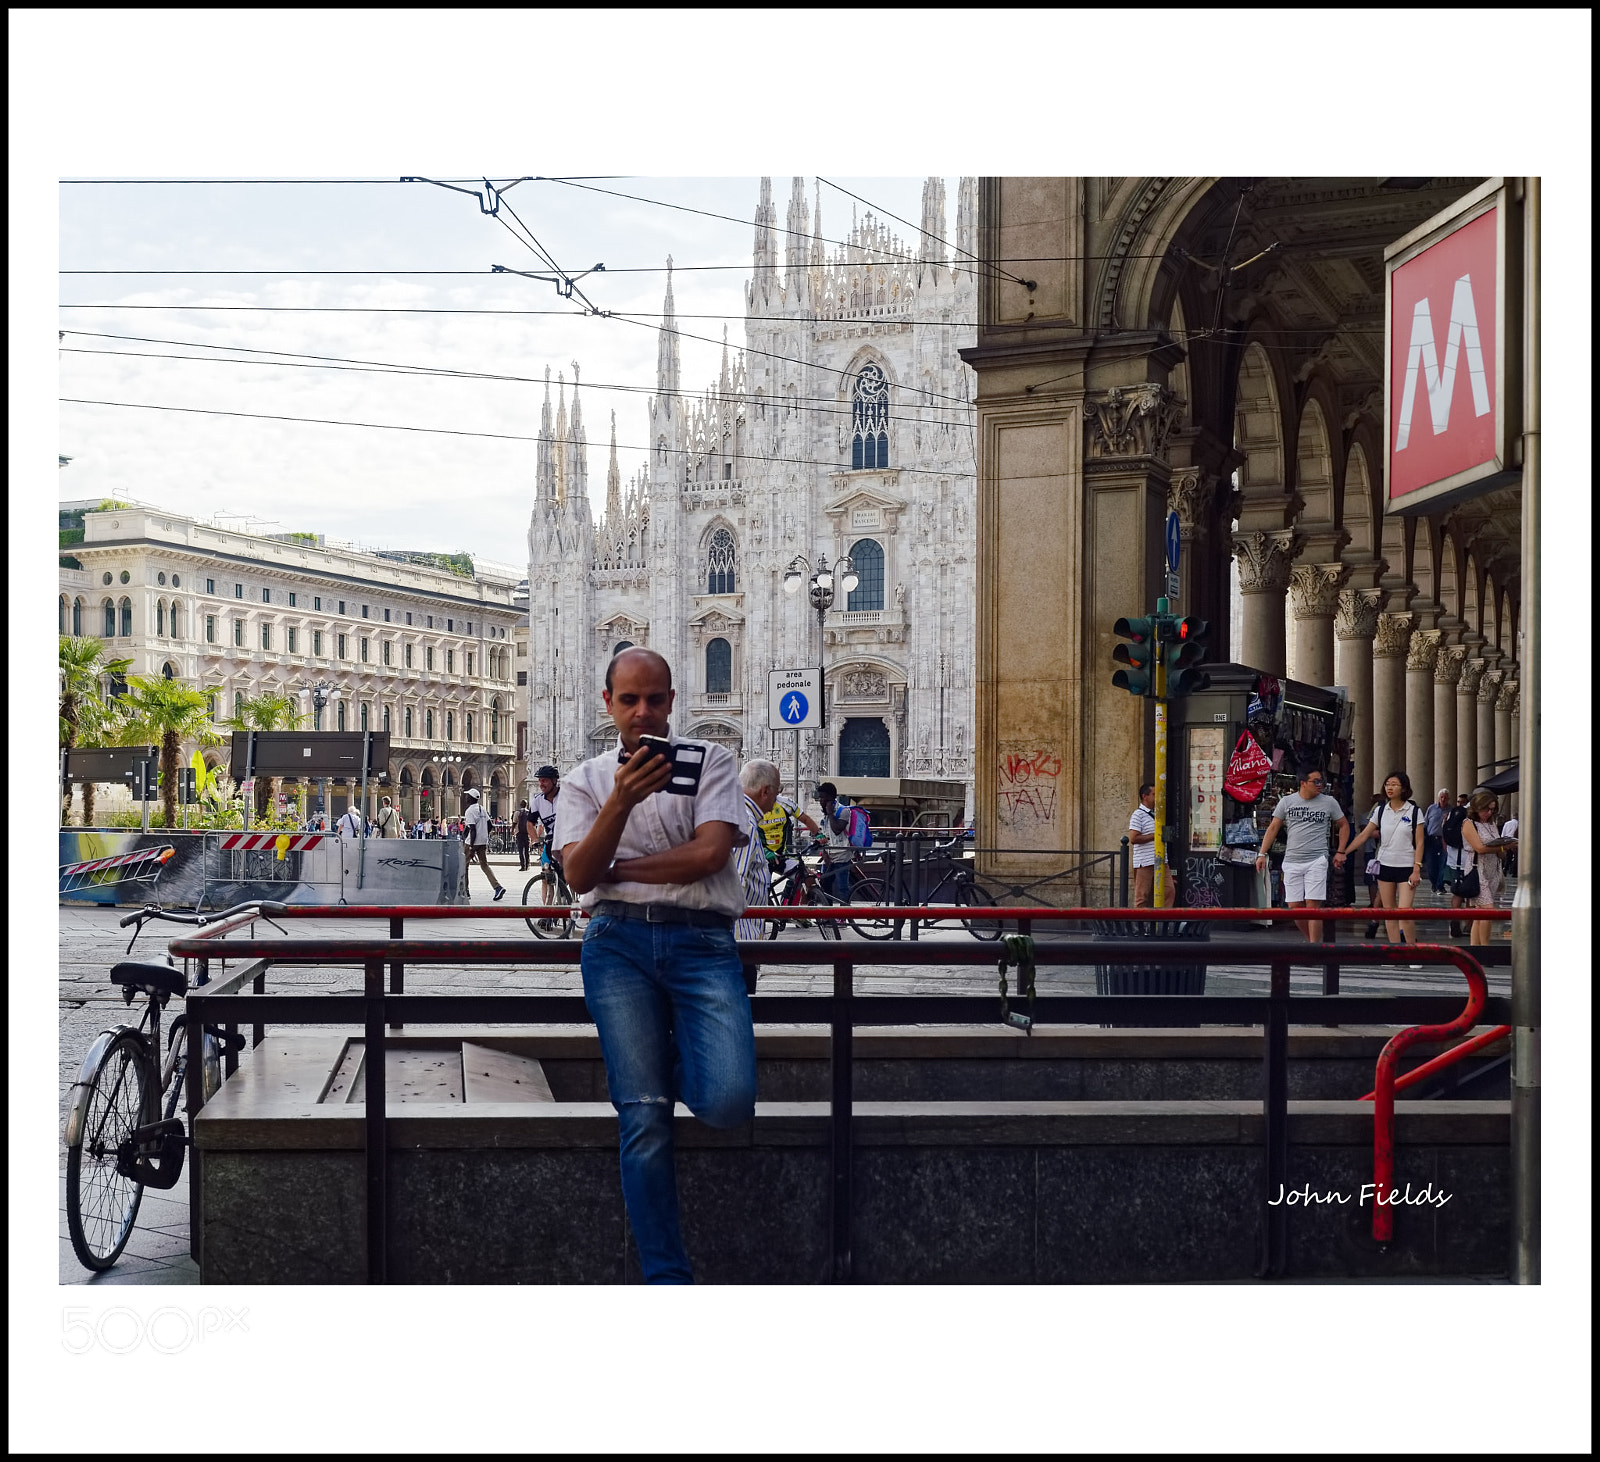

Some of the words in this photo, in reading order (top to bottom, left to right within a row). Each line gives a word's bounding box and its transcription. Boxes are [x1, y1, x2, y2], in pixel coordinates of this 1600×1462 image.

[1395, 273, 1491, 452] M
[776, 680, 812, 689] pedonale
[1197, 763, 1205, 803] COLD
[1208, 763, 1217, 824] DRINKS
[997, 788, 1056, 820] TAV
[1288, 811, 1326, 819] HILFIGER
